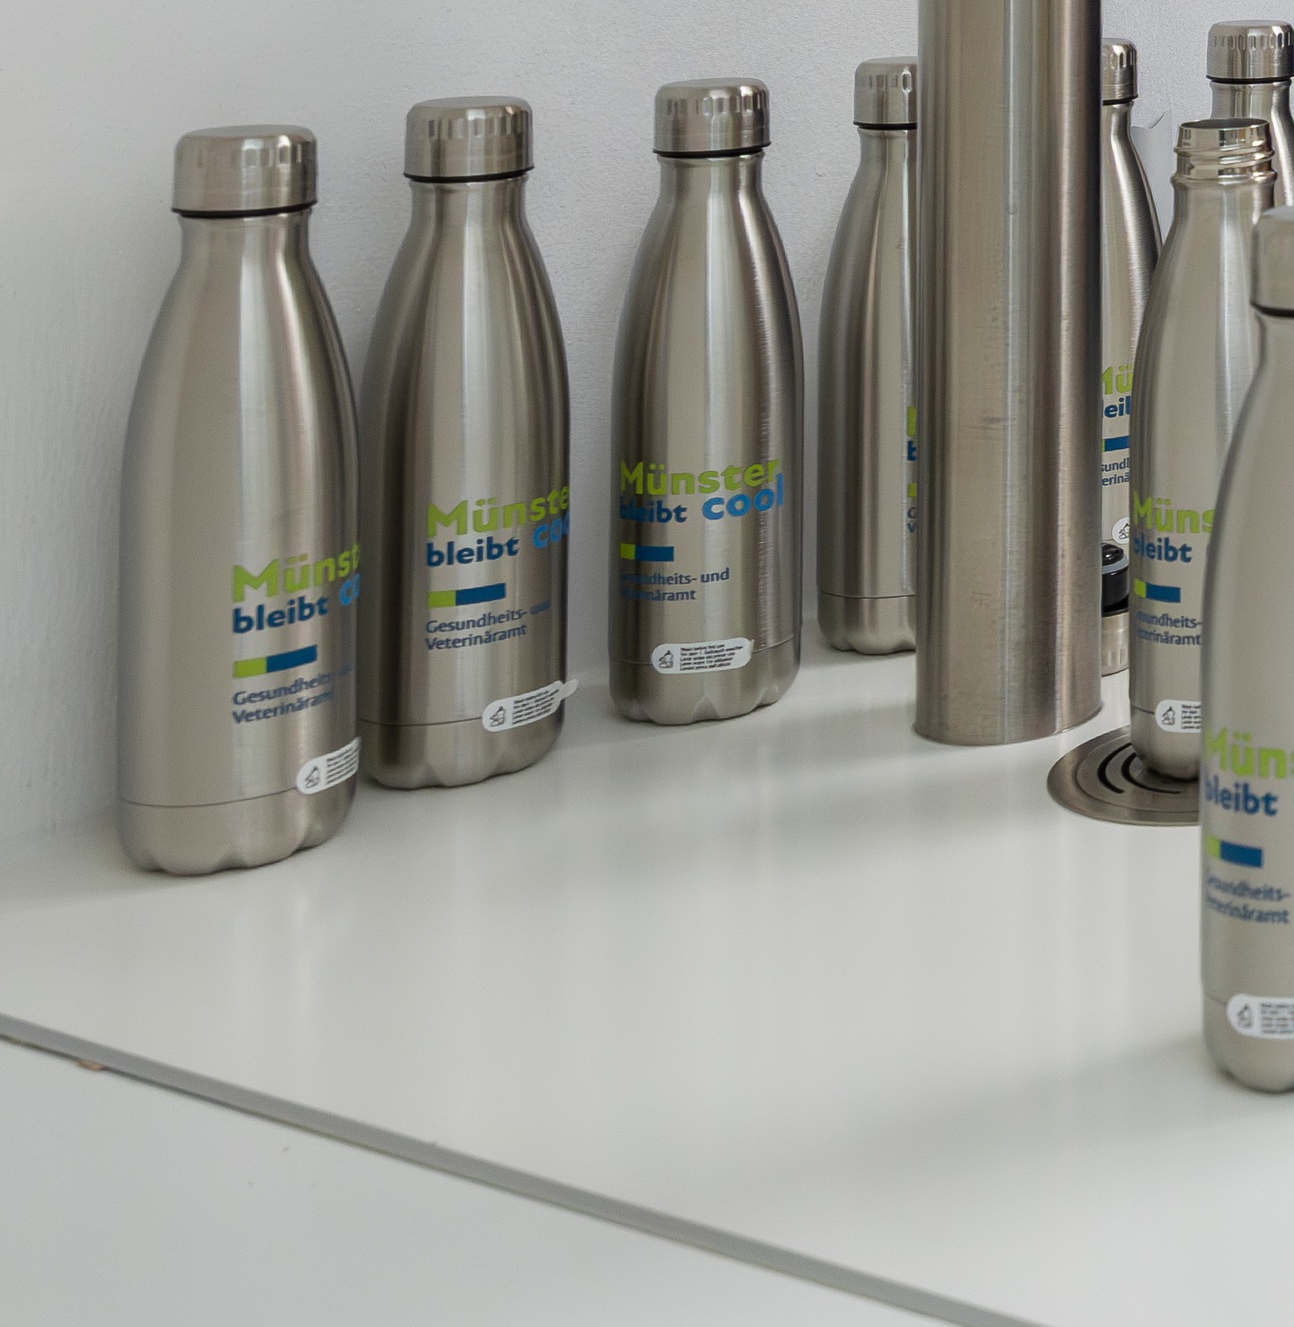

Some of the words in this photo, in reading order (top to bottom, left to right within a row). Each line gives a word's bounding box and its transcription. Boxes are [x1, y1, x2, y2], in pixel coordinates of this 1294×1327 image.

[620, 459, 780, 495] Münster
[702, 474, 784, 521] cool
[426, 536, 520, 567] bleibt
[700, 566, 730, 584] und
[232, 595, 330, 635] bleibt
[426, 609, 528, 634] Gesundheits-
[425, 624, 527, 651] Veterinäramt
